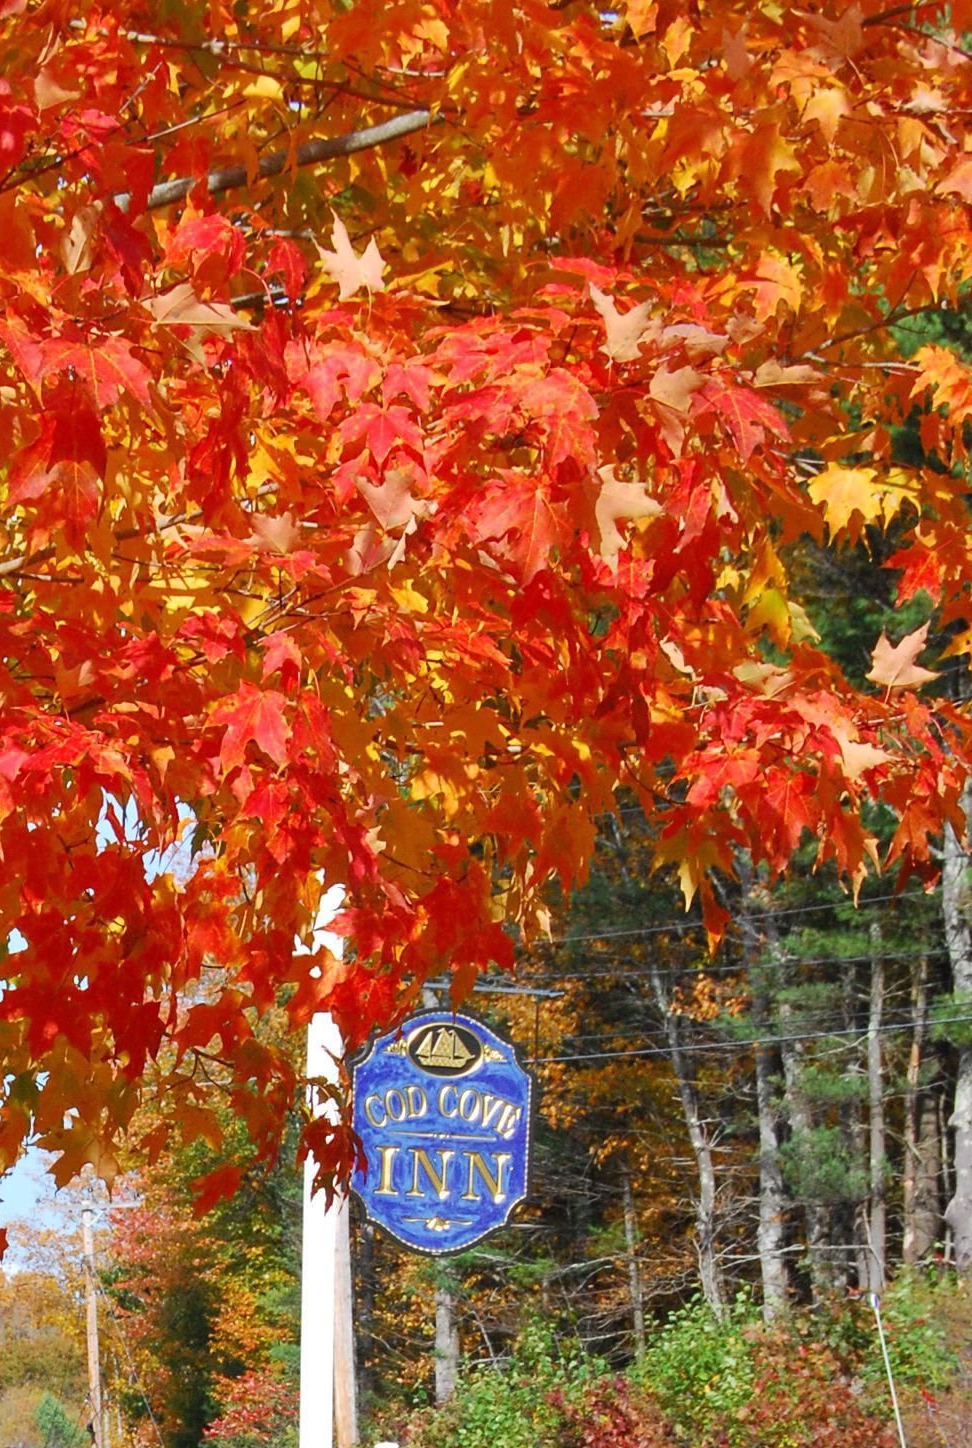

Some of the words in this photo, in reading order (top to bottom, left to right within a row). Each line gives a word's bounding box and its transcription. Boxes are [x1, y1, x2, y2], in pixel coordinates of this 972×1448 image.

[364, 1084, 428, 1128] COD
[439, 1084, 523, 1139] COVE
[373, 1146, 511, 1204] INN
